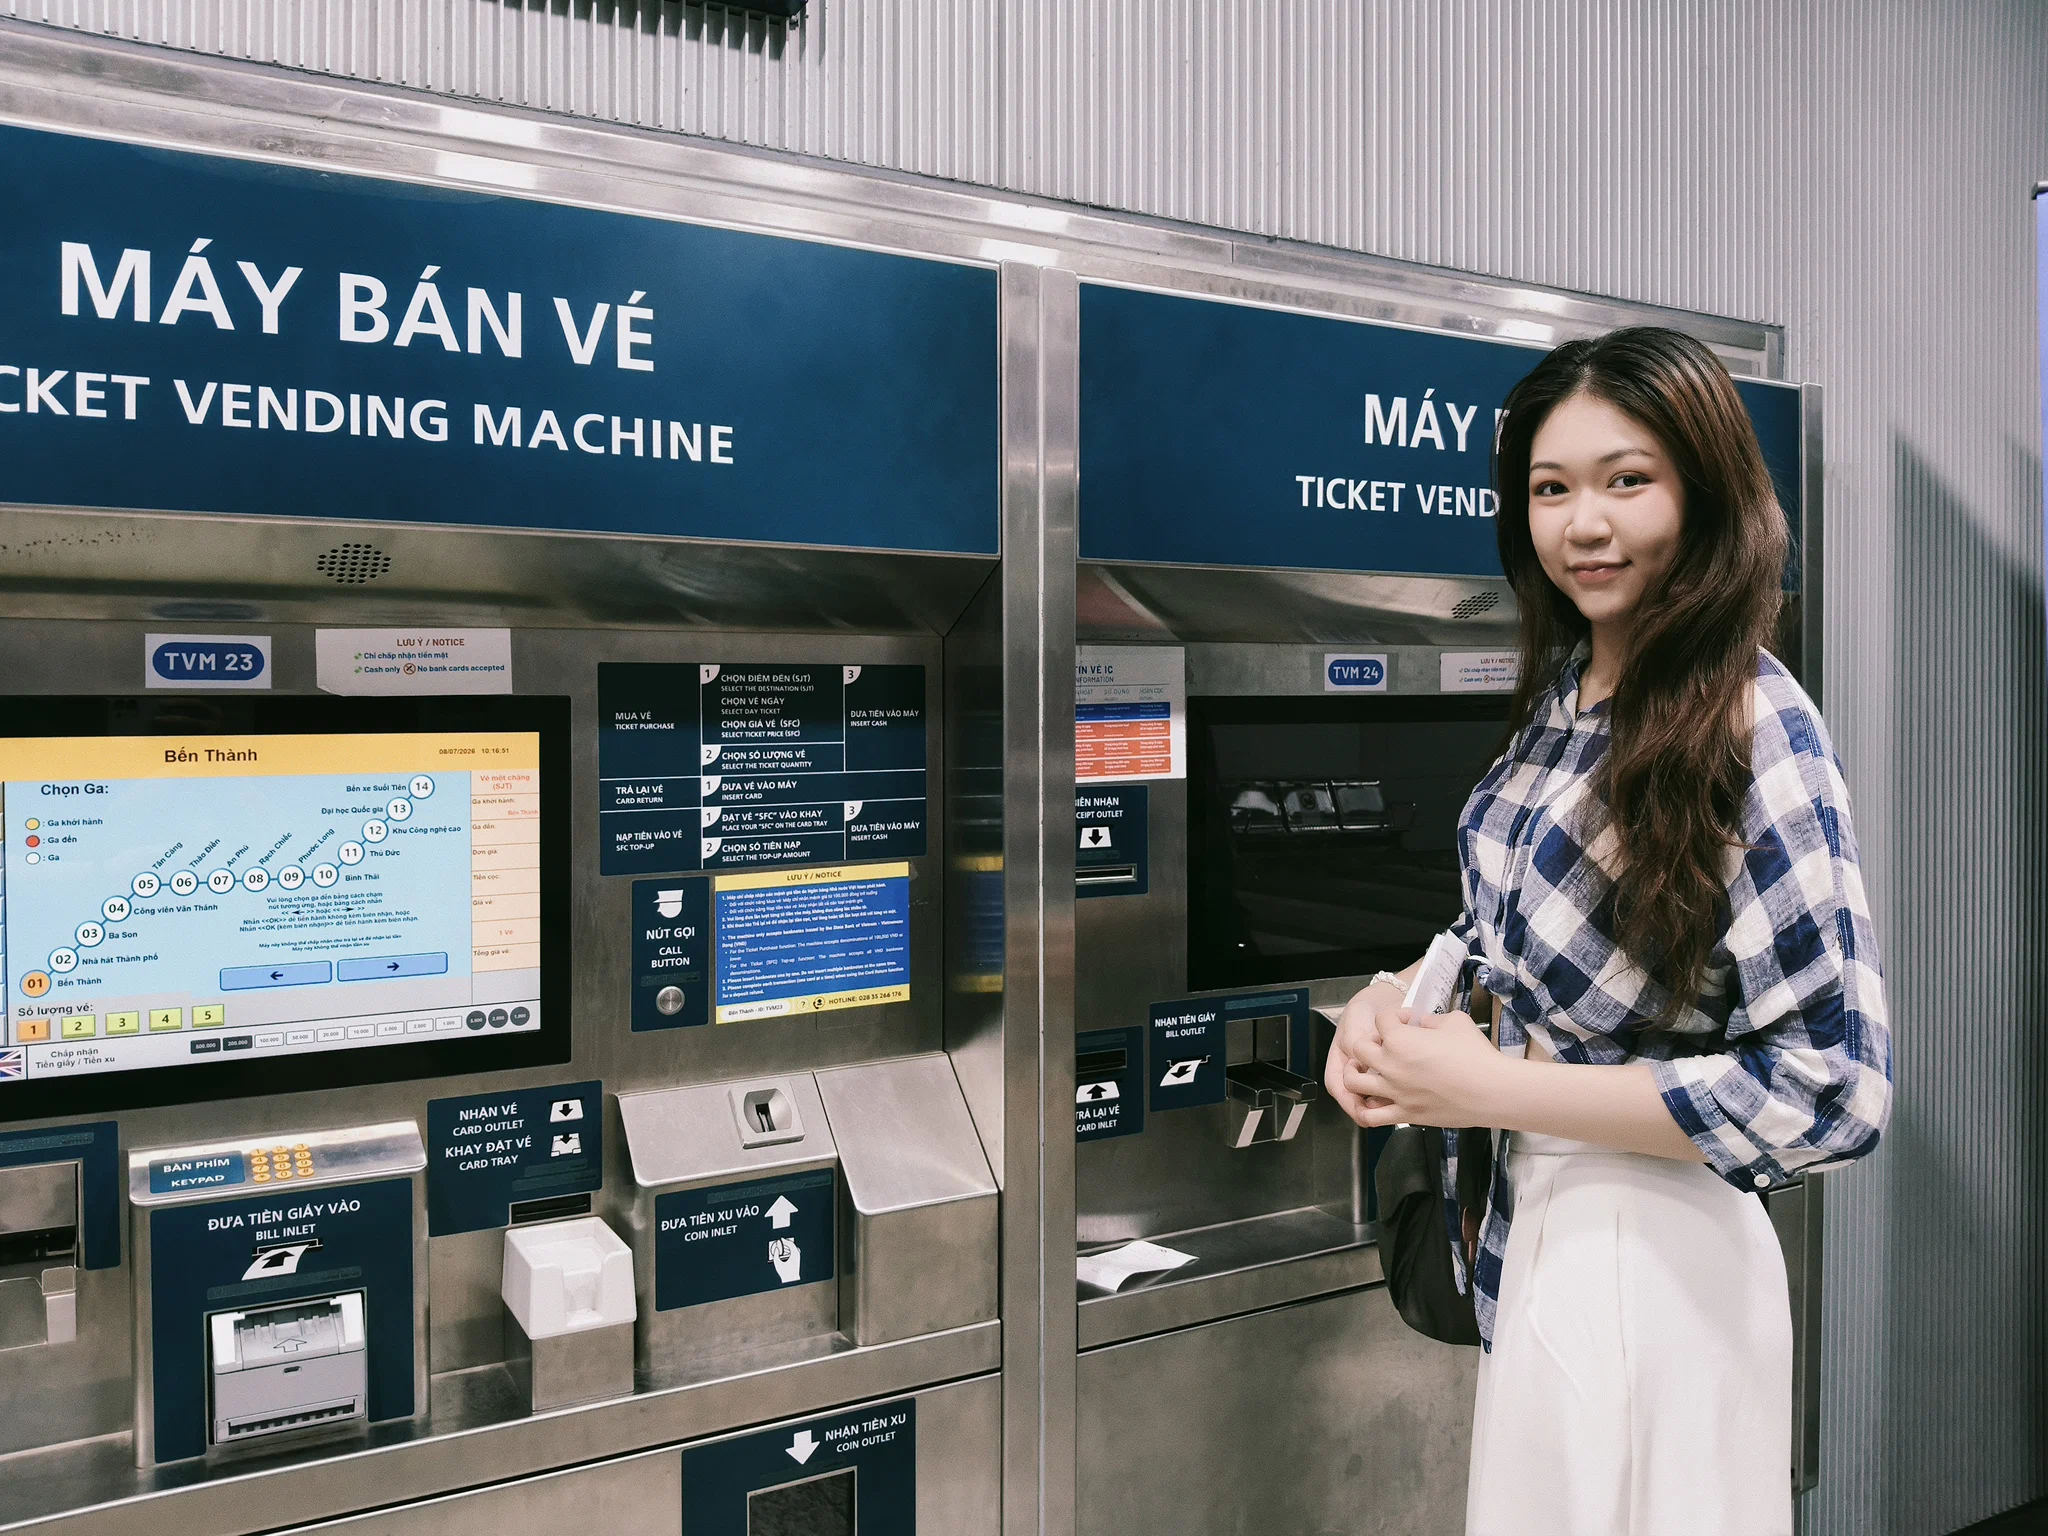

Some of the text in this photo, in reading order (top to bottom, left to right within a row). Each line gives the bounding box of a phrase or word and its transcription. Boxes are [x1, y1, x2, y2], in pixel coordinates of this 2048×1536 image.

[61, 238, 655, 372] MÁY BÁN VÉ
[173, 379, 449, 442] VENDING
[474, 404, 734, 465] MACHINE
[1365, 388, 1478, 452] MÁY
[1295, 475, 1406, 513] TICKET
[396, 639, 415, 647] LƯU
[425, 638, 430, 647] /
[432, 638, 465, 646] NOTICE
[164, 652, 254, 672] TVM 23
[364, 666, 383, 674] Cash
[385, 666, 400, 675] only
[470, 664, 505, 673] accepted
[705, 669, 710, 679] 1
[1076, 665, 1088, 674] IN
[1104, 665, 1113, 674] IC
[1333, 666, 1379, 679] TVM 24
[721, 696, 785, 706] CHỌN VÉ NGÀY
[615, 711, 652, 720] MUA VÉ
[165, 747, 258, 762] Bến Thành
[706, 750, 712, 758] 2
[41, 783, 109, 797] Chọn Ga:
[415, 783, 428, 791] 14
[616, 784, 663, 796] TRẢ LẠI VÉ
[722, 780, 797, 791] ĐƯA VÉ VÀO MÁY
[1093, 796, 1119, 808] NHẬN
[393, 804, 406, 813] 13
[1096, 810, 1123, 818] OUTLET
[369, 826, 382, 835] 12
[345, 848, 358, 857] 11
[629, 843, 655, 851] TOP-UP
[226, 855, 237, 868] An
[213, 876, 229, 885] 07
[249, 874, 264, 884] 08
[284, 873, 299, 882] 09
[319, 870, 333, 879] 10
[787, 873, 804, 881] LƯU
[815, 871, 842, 879] NOTICE
[138, 879, 154, 889] 05
[176, 878, 192, 887] 06
[108, 904, 125, 913] 04
[82, 929, 98, 938] 03
[646, 926, 695, 940] NÚT GỌI
[659, 946, 682, 955] CALL
[55, 955, 71, 964] 02
[651, 957, 690, 968] BUTTON
[27, 979, 43, 989] 01
[829, 996, 858, 1005] HOTLINE:
[858, 993, 871, 1001] 028
[892, 990, 902, 998] 176
[18, 1003, 93, 1016] Số lượng vé:
[30, 1011, 212, 1035] 1 2 3 4 5
[1155, 1017, 1177, 1028] NHẬN
[1179, 1013, 1196, 1024] TIỀN
[1165, 1026, 1206, 1038] BILL OUTLET
[460, 1102, 517, 1121] NHẬN VÉ
[1093, 1108, 1107, 1119] LẠI
[1108, 1104, 1120, 1115] VÉ
[453, 1119, 524, 1136] CARD OUTLET
[1076, 1120, 1117, 1133] CARD INLET
[445, 1135, 532, 1158] KHAY ĐẶT VÉ
[163, 1158, 230, 1173] BÀN PHÍM
[460, 1155, 518, 1171] CARD TRAY
[171, 1175, 225, 1187] KEYPAD
[208, 1198, 361, 1231] ĐƯA TIỀN GIẤY VÀO
[661, 1205, 759, 1231] ĐƯA TIỀN XU VÀO
[255, 1223, 316, 1241] BILL INLET
[684, 1225, 738, 1242] COIN INLET
[825, 1413, 906, 1441] NHẬN TIỀN XU
[836, 1431, 896, 1453] COIN OUTLET
